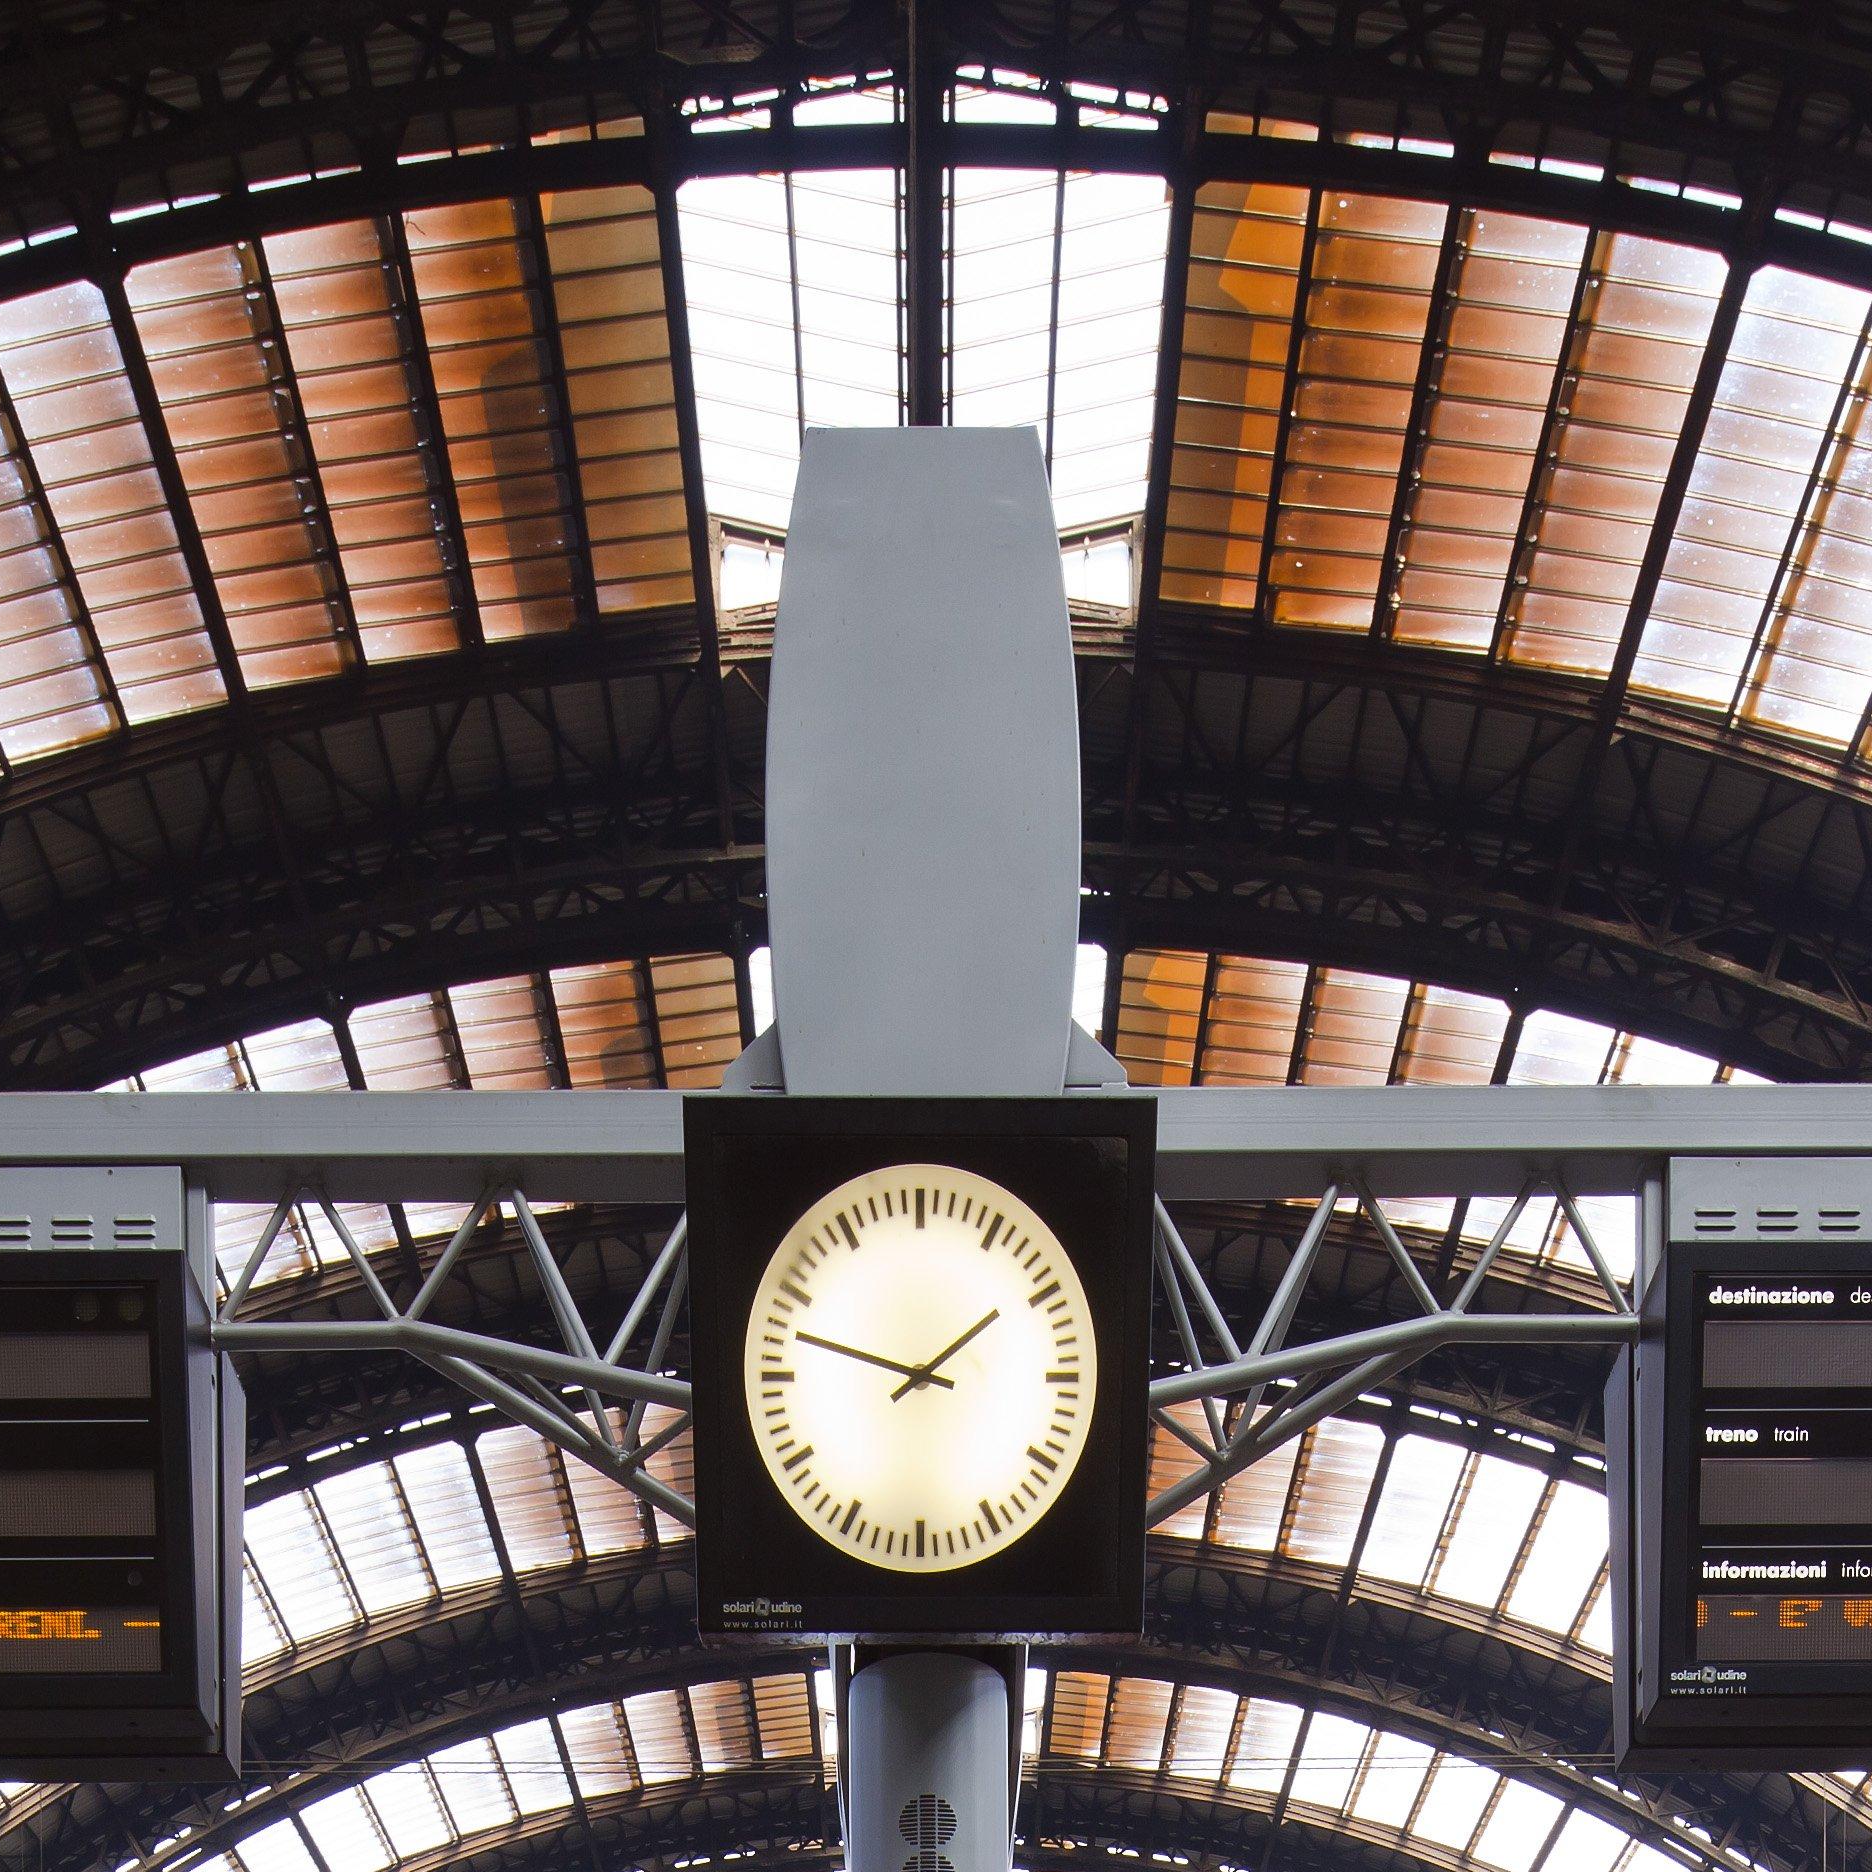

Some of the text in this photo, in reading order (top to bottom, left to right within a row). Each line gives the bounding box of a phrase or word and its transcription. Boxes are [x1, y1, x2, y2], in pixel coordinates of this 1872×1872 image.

[1708, 1285, 1835, 1305] destinazione
[1705, 1426, 1809, 1443] treno train
[1702, 1559, 1827, 1579] informazioni
[722, 1601, 803, 1613] solari udine
[723, 1619, 803, 1629] www.solari.it
[1670, 1669, 1747, 1681] solari udine
[1670, 1685, 1747, 1695] www.solari.it
